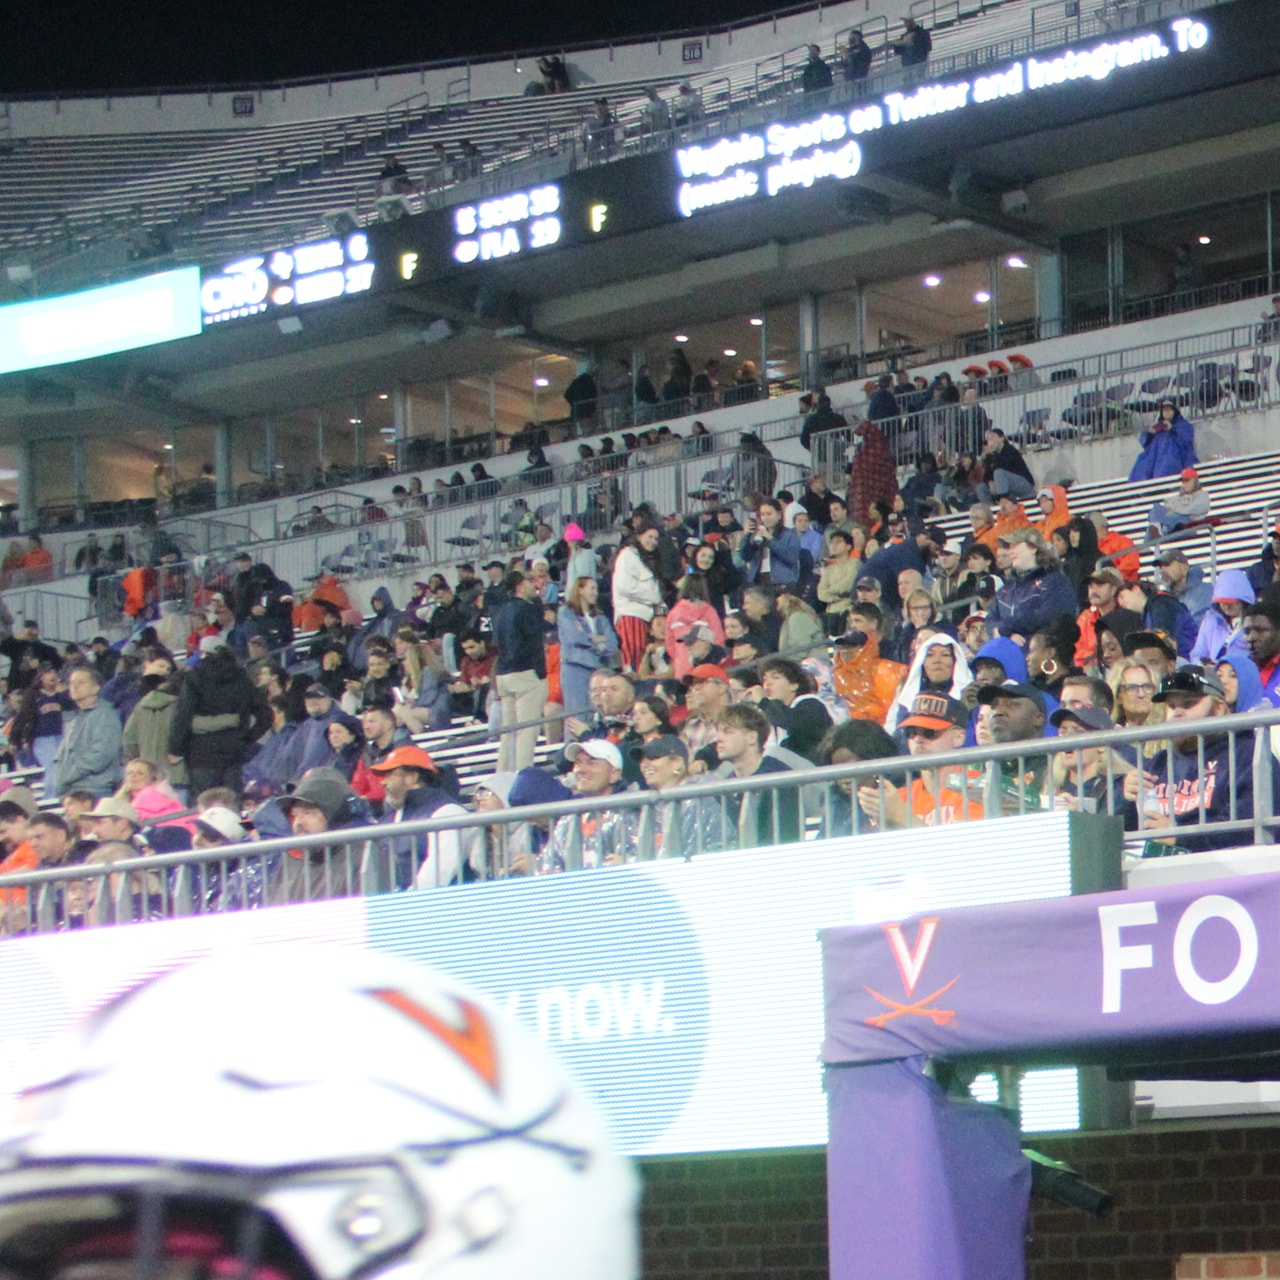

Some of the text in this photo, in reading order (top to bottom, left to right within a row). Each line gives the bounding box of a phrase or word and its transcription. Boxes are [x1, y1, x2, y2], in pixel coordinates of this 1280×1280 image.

[677, 18, 1209, 177] Virginia Sports on Twitter and Instagram. To
[766, 139, 862, 197] playing)
[591, 204, 608, 233] F
[401, 252, 419, 281] F
